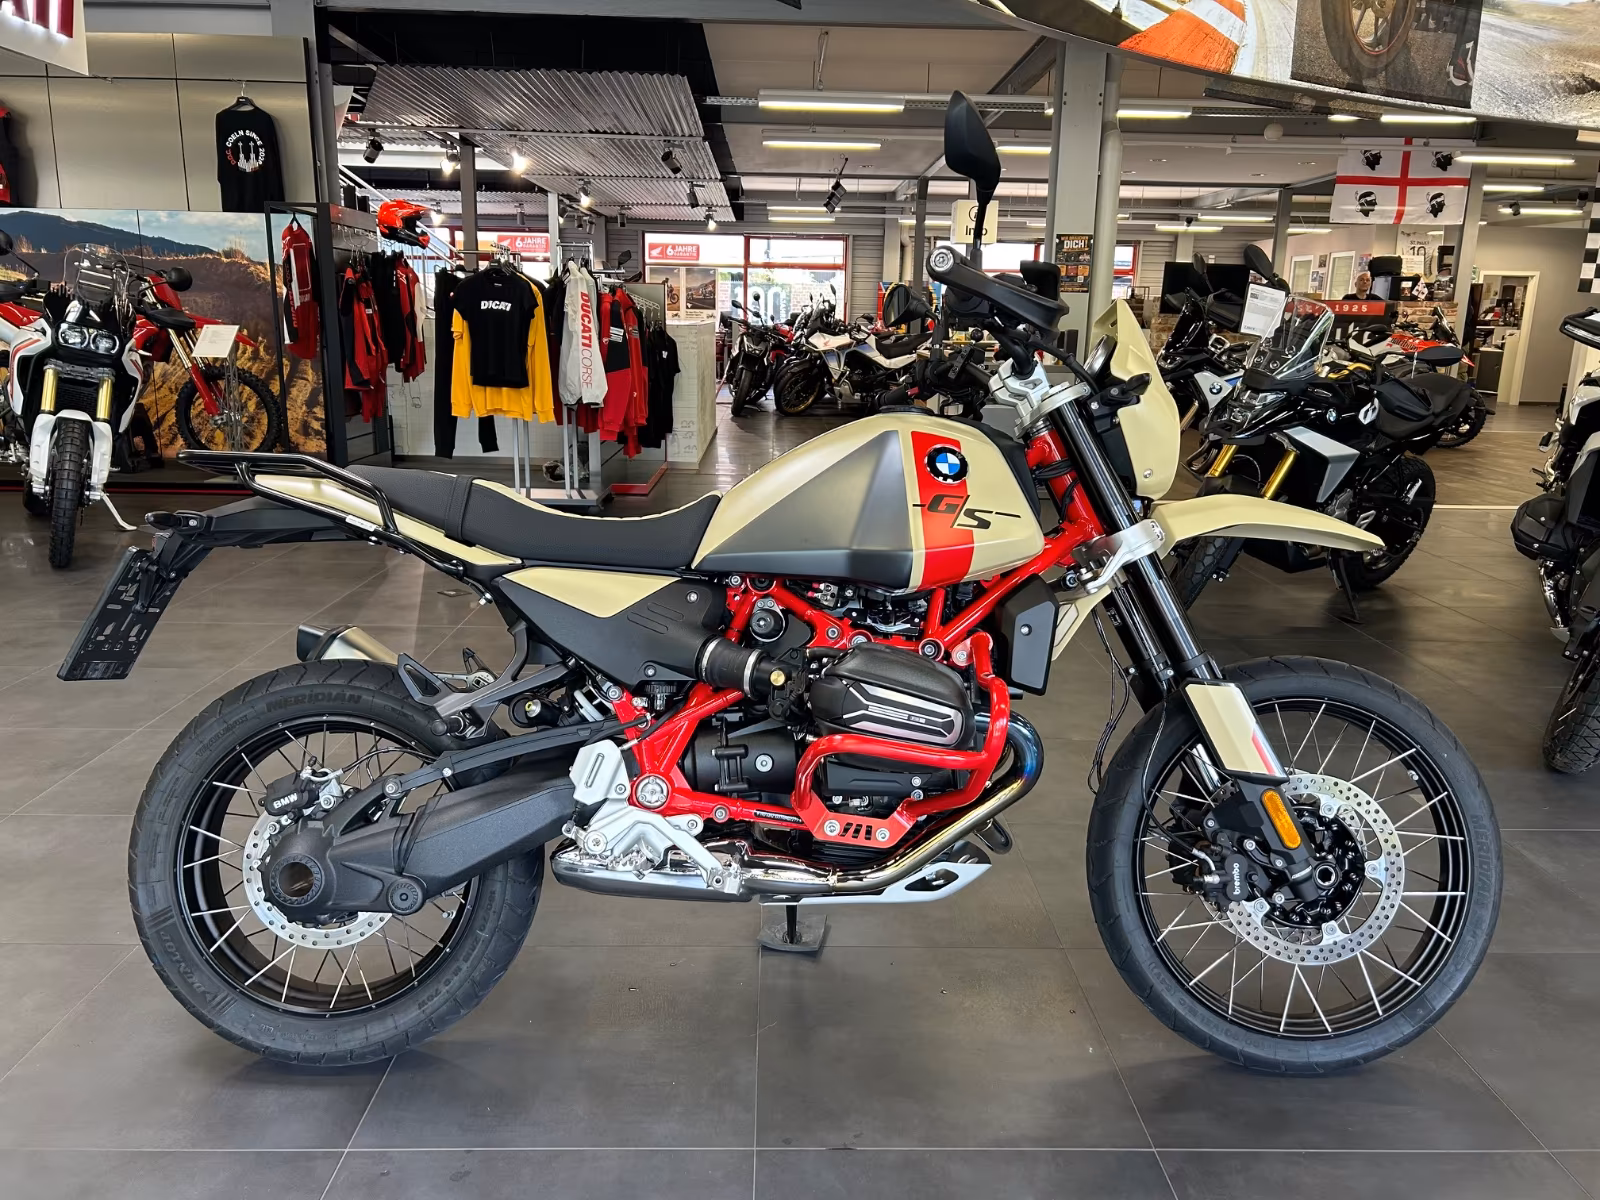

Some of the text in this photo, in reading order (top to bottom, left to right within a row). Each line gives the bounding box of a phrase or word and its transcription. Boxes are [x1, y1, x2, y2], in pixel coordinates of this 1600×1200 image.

[225, 129, 244, 147] COELN
[245, 129, 264, 146] SINCE
[965, 225, 988, 236] Ino
[515, 236, 523, 248] 6
[1064, 239, 1088, 249] DICH!
[666, 245, 675, 257] 6
[1334, 304, 1368, 313] 1925
[580, 291, 593, 389] DUCATI CORSE
[273, 793, 298, 809] BMW
[1232, 862, 1241, 895] brembo
